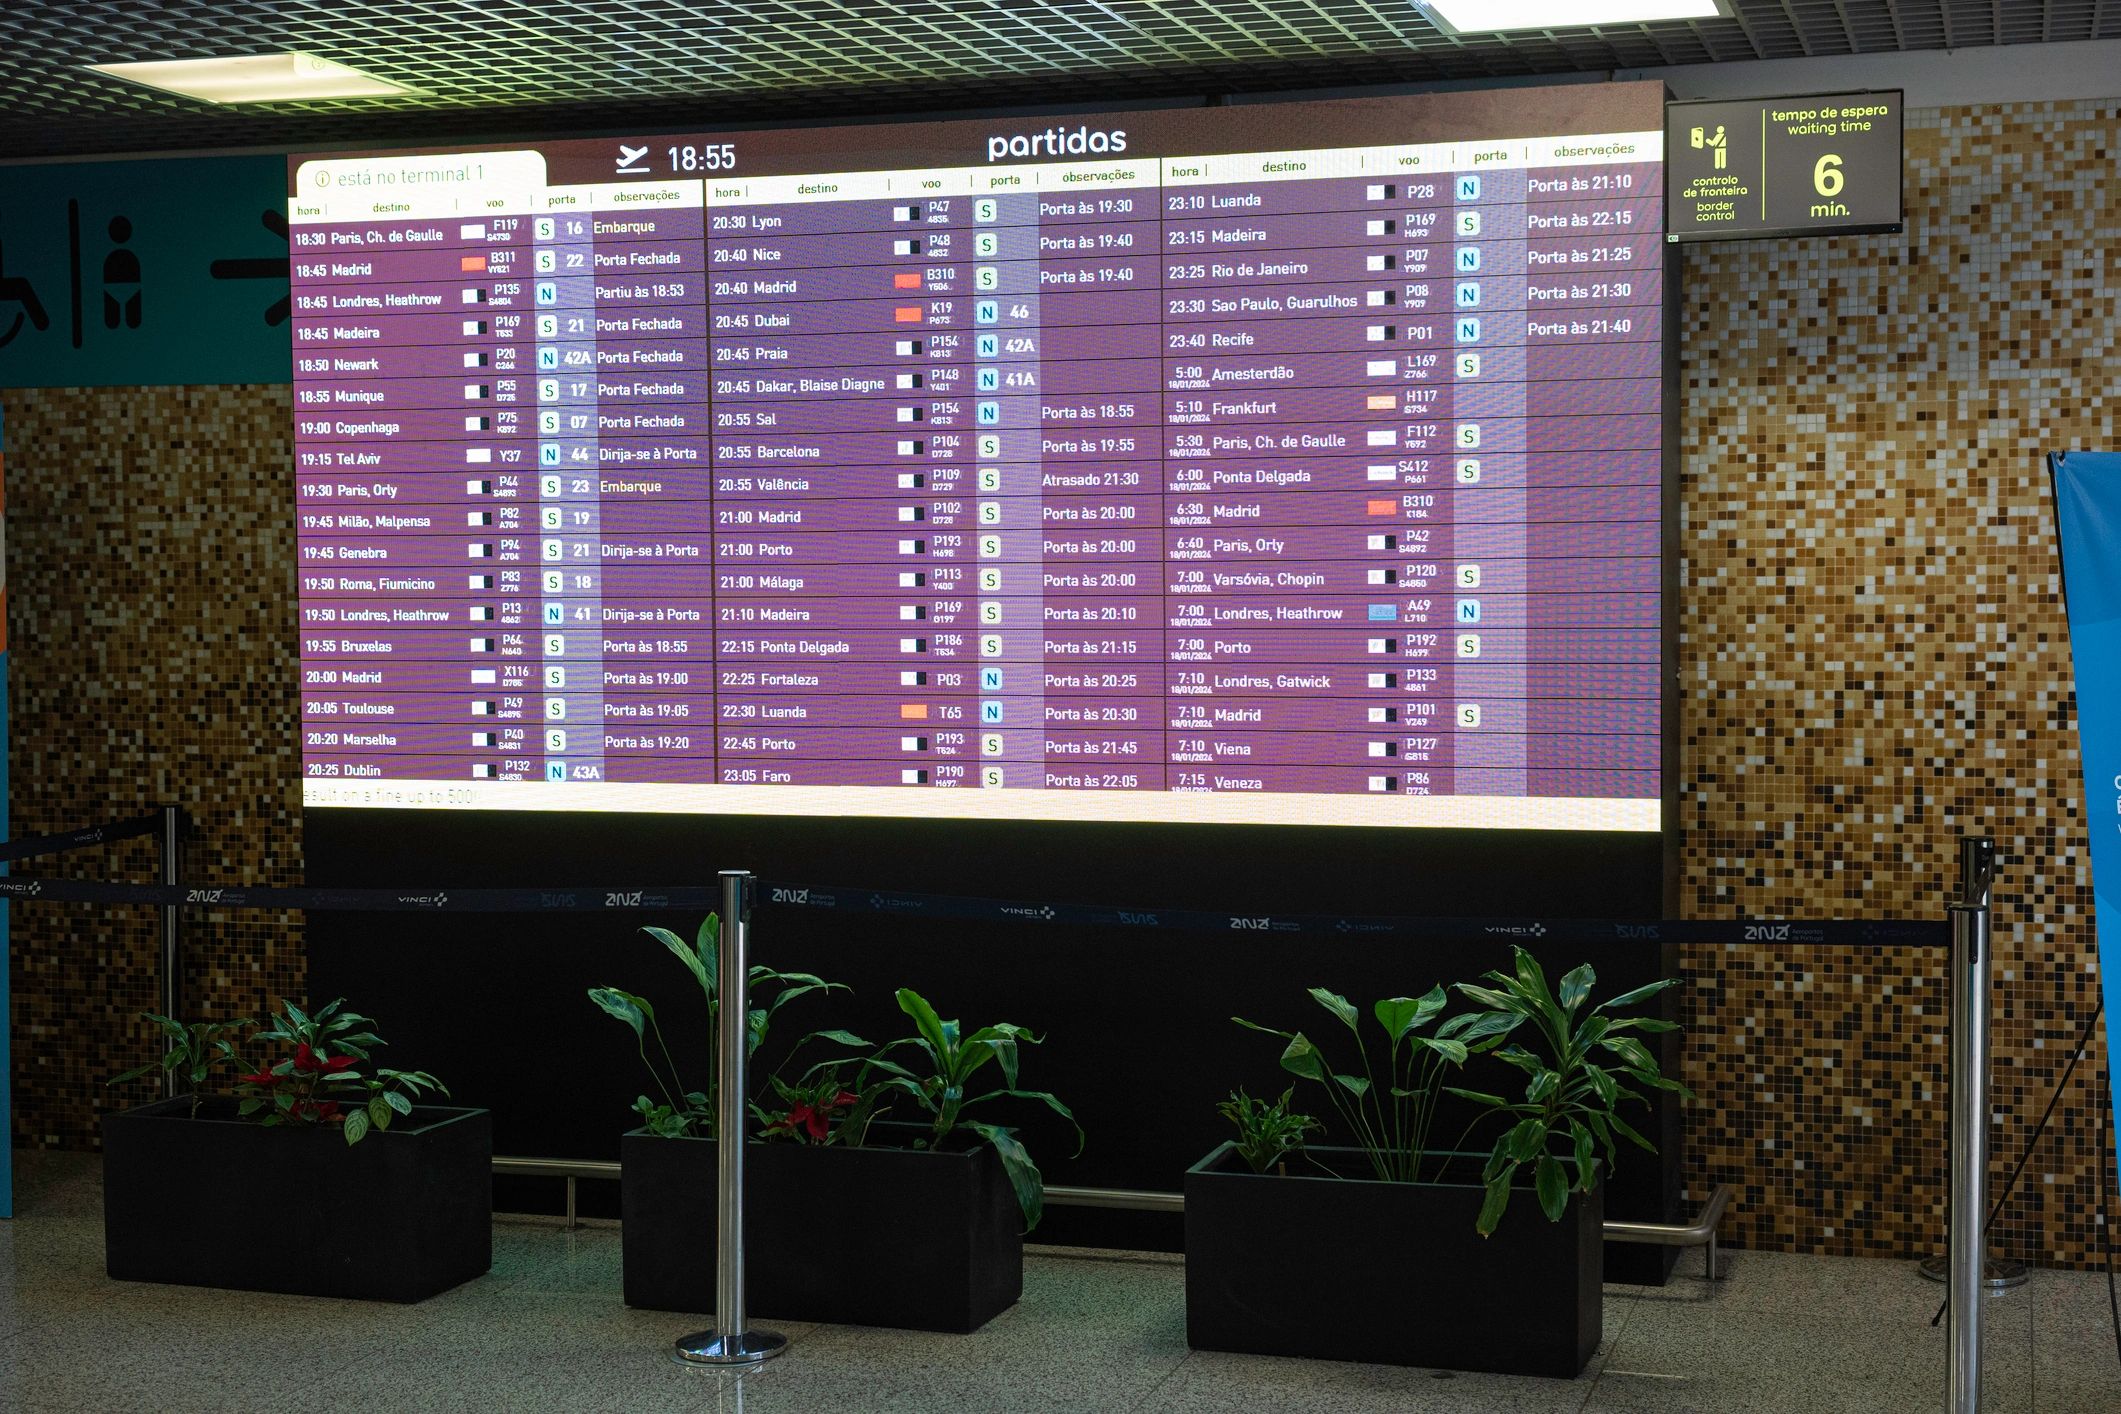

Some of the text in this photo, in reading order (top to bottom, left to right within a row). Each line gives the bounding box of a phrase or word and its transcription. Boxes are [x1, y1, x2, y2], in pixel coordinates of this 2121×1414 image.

[1771, 105, 1888, 122] tempo de espera
[1787, 120, 1872, 136] waiting time
[988, 125, 1126, 162] partidas
[668, 143, 736, 172] 18:55
[1171, 142, 1634, 176] hora destino voo porta observações
[338, 163, 484, 186] está no terminal 1
[1692, 174, 1738, 186] controlo
[1813, 153, 1844, 196] 6
[715, 168, 1136, 198] hora destino voo porta observações
[1168, 184, 1434, 210] 23:10 Luanda P28
[1683, 185, 1748, 198] de fronteira
[297, 189, 680, 216] hora destino voo porta observações
[1696, 200, 1734, 212] border
[1810, 200, 1850, 218] min.
[712, 200, 950, 231] 20:30 Lyon P47
[1695, 210, 1734, 222] control
[295, 232, 326, 246] 18:30
[330, 231, 364, 245] Paris,
[365, 230, 386, 243] Ch.
[387, 229, 403, 243] de
[405, 228, 443, 242] Gaulle
[493, 218, 518, 231] F119
[566, 221, 583, 235] 16
[593, 220, 655, 235] Embarque
[1211, 227, 1266, 243] Madeira
[752, 247, 781, 261] Nice
[295, 250, 681, 277] 18:45 Madrid B311 22 Porta Fechada
[1211, 260, 1308, 277] Rio de Janeiro
[753, 279, 797, 294] Madrid
[332, 283, 685, 308] Londres, Heathrow Partiu às 18:53
[1211, 294, 1358, 312] Sao Paulo, Guarulhos
[754, 312, 790, 327] Dubai
[333, 326, 380, 339] Madeira
[1212, 331, 1254, 346] Recife
[755, 346, 788, 359] Praia
[333, 357, 379, 371] Newark
[1211, 365, 1294, 381] Amesterdão
[755, 377, 885, 393] Dakar, Blaise Diagne
[334, 389, 384, 405] Munique
[1212, 400, 1276, 415] Frankfurt
[755, 412, 777, 426] Sal
[335, 420, 400, 436] Copenhaga
[1212, 433, 1346, 450] Paris, Ch. de Gaulle
[335, 452, 381, 465] Tel Aviv
[756, 445, 820, 458] Barcelona
[756, 471, 1139, 491] Valência Atrasado 21:30
[1213, 468, 1311, 485] Ponta Delgada
[337, 483, 398, 499] Paris, Orly
[758, 510, 801, 523] Madrid
[1213, 503, 1260, 518] Madrid
[337, 514, 431, 530] Milão, Malpensa
[338, 546, 387, 559] Genebra
[758, 543, 793, 556] Porto
[1213, 537, 1284, 554] Paris, Orly
[339, 577, 435, 592] Roma, Fiumicino
[759, 575, 804, 591] Málaga
[1212, 572, 1324, 588] Varsóvia, Chopin
[340, 608, 449, 623] Londres, Heathrow
[759, 607, 810, 621] Madeira
[1214, 606, 1343, 622] Londres, Heathrow
[340, 639, 392, 652] Bruxelas
[760, 640, 849, 656] Ponta Delgada
[1214, 640, 1251, 653] Porto
[341, 670, 382, 683] Madrid
[760, 672, 819, 686] Fortaleza
[1214, 674, 1331, 689] Londres, Gatwick
[341, 701, 395, 715] Toulouse
[761, 704, 807, 718] Luanda
[1214, 708, 1261, 721] Madrid
[342, 733, 397, 746] Marselha
[761, 737, 796, 750] Porto
[1213, 741, 1251, 755] Viena
[344, 763, 381, 778] Dublin
[762, 769, 791, 782] Faro
[1213, 775, 1262, 789] Veneza
[398, 896, 432, 904] VINCI
[1000, 907, 1038, 915] VINCI
[1484, 926, 1527, 934] VINCI
